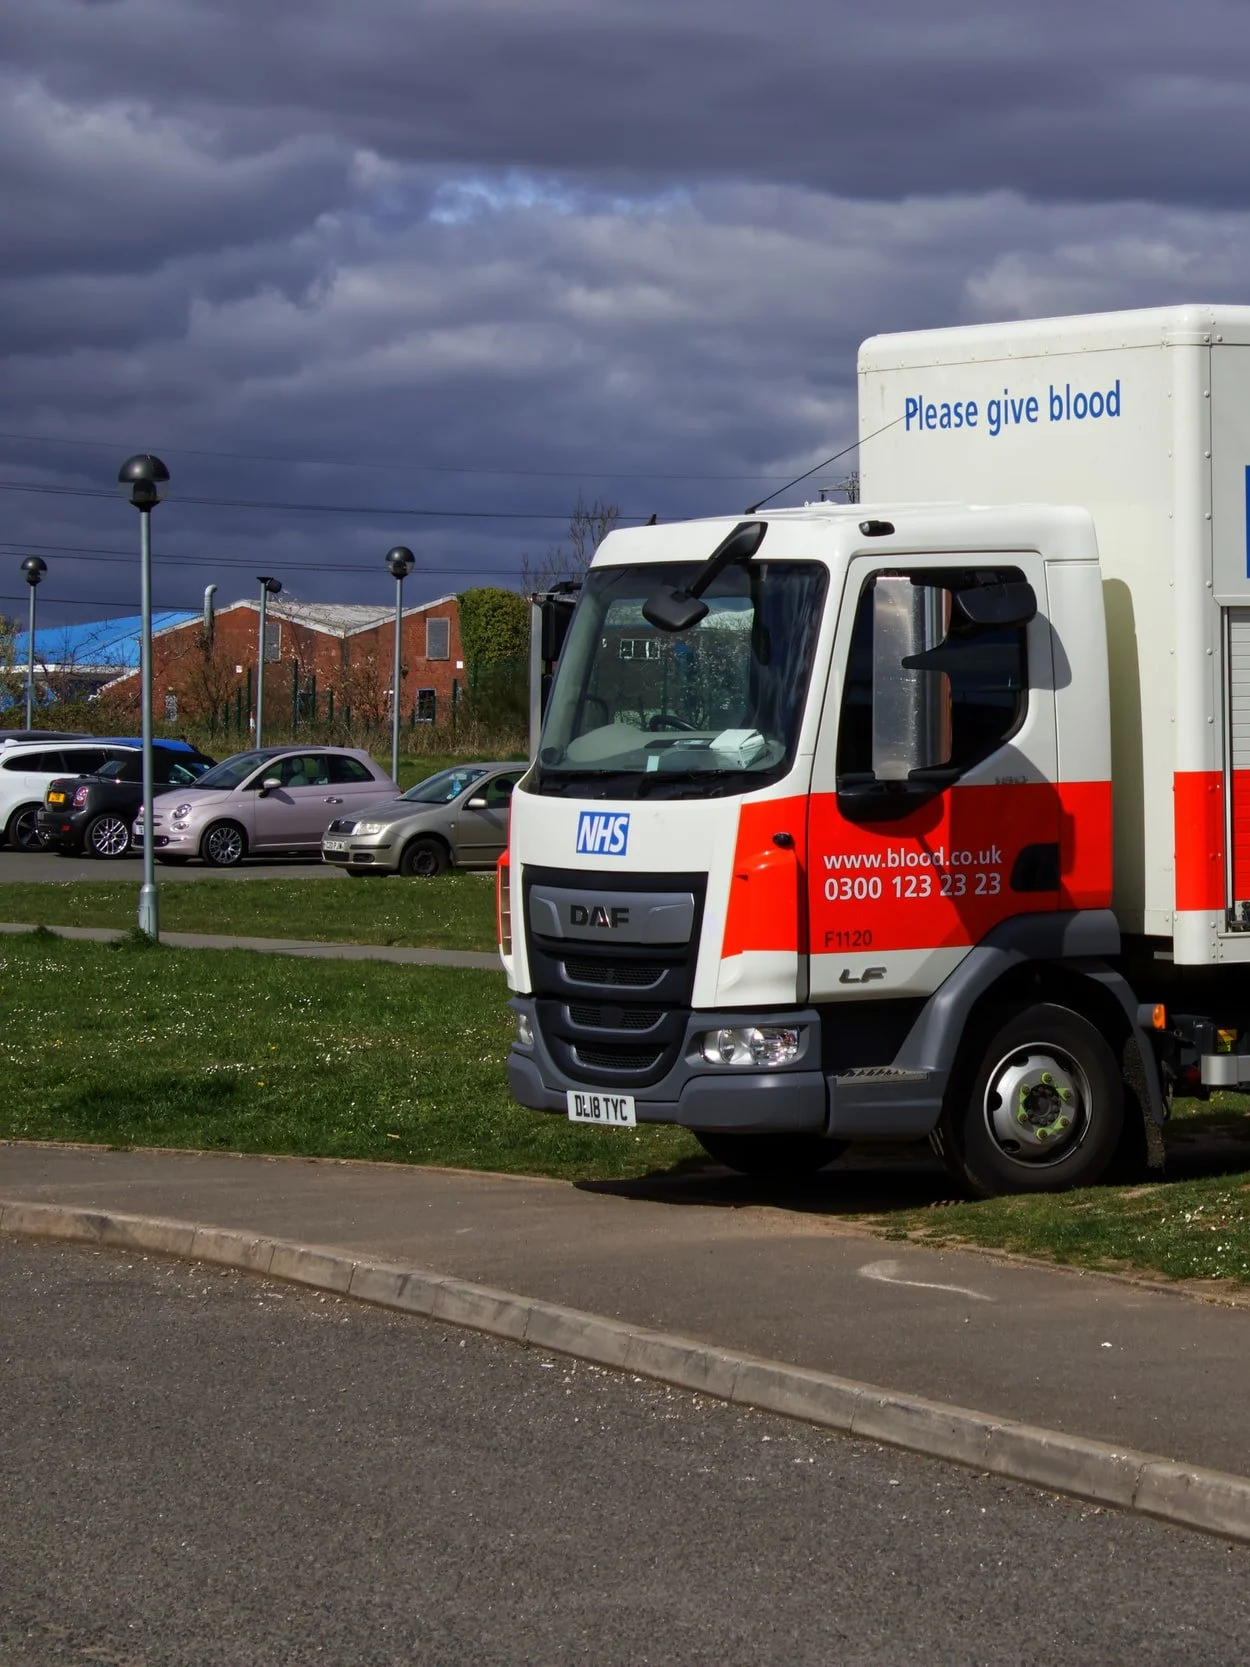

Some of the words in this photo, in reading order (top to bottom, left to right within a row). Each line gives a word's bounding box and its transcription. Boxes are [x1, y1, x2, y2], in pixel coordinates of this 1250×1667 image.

[904, 396, 978, 431] Please
[987, 389, 1039, 437] give
[1049, 380, 1121, 422] blood
[577, 815, 629, 853] NHS
[823, 845, 1003, 870] www.blood.co.uk
[824, 876, 882, 901] 0300
[892, 875, 932, 898] 123
[940, 873, 967, 897] 23
[975, 872, 1001, 895] 23
[570, 904, 629, 928] DAF
[824, 929, 873, 948] F1120
[839, 966, 888, 985] LF
[574, 1094, 601, 1119] DL18
[603, 1097, 628, 1121] TYC
